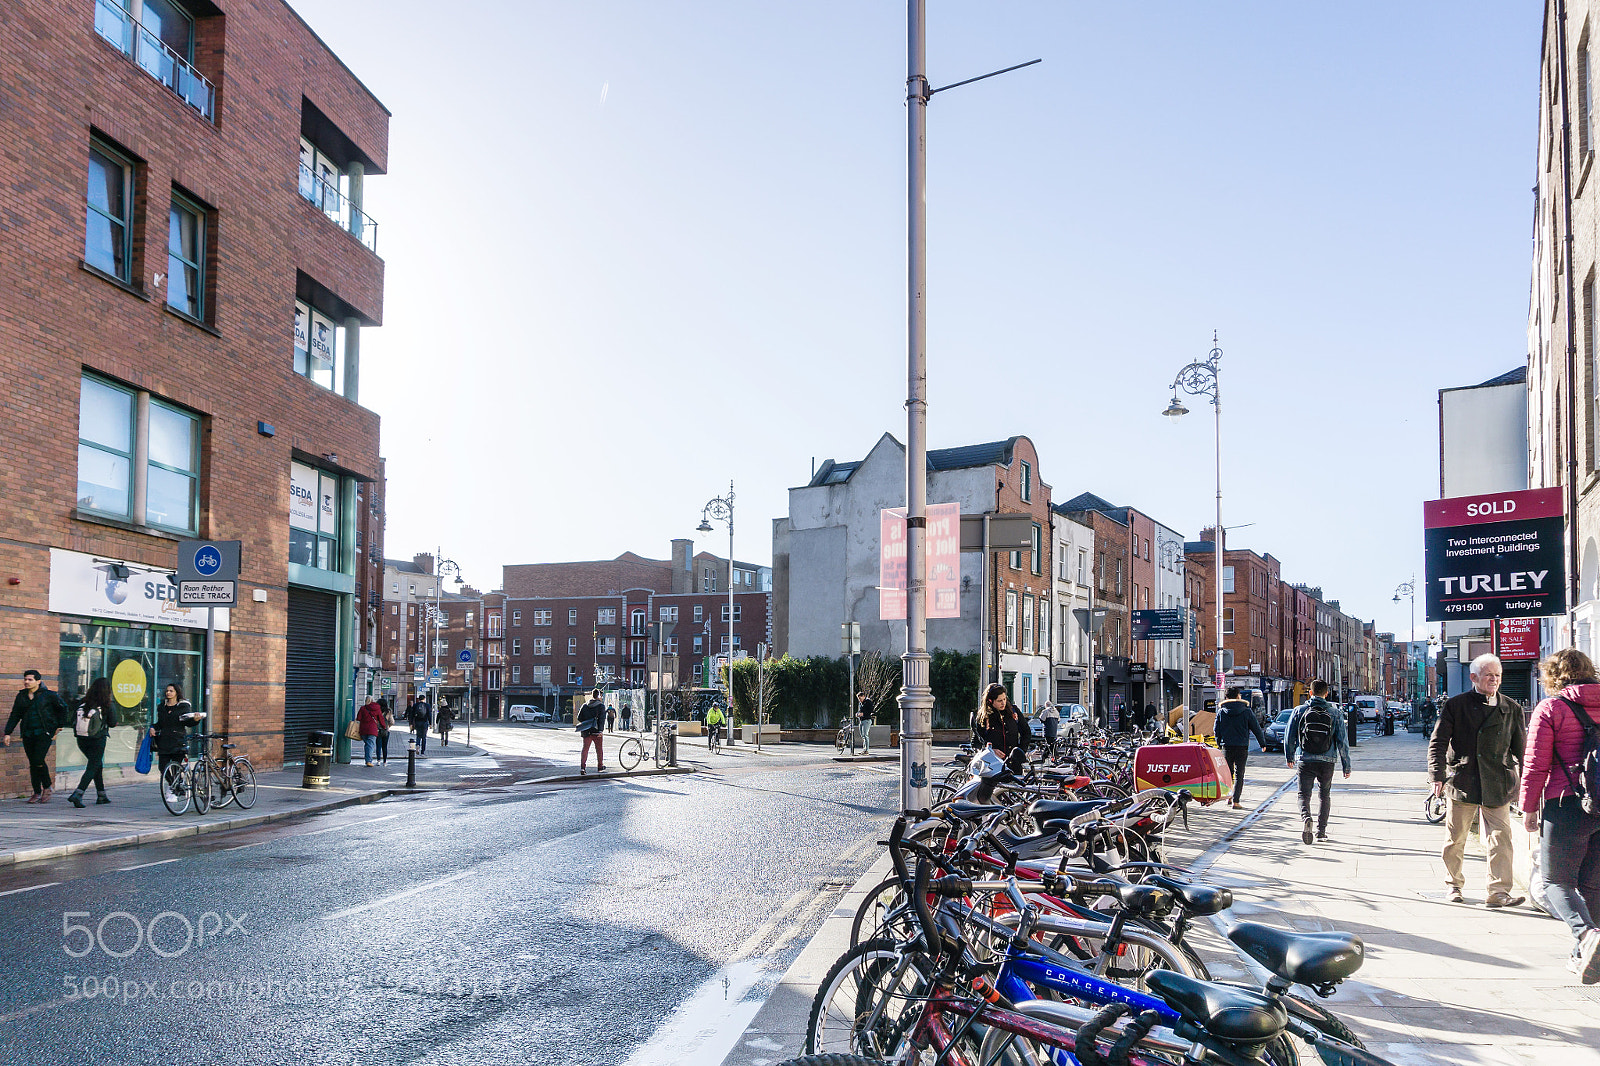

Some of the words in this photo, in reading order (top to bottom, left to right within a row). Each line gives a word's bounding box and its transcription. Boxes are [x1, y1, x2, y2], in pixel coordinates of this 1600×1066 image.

[312, 337, 330, 356] SEDA
[290, 484, 313, 501] SEDA
[1466, 500, 1517, 517] SOLD
[1448, 537, 1467, 547] Two
[1469, 531, 1538, 545] Interconnected
[1446, 546, 1496, 557] Investment
[1497, 542, 1540, 554] Buildings
[1438, 569, 1549, 595] TURLEY
[144, 581, 178, 601] SED
[183, 592, 205, 600] CYCLE
[207, 592, 231, 600] TRACK
[1445, 603, 1484, 613] 4791500
[1505, 600, 1542, 611] turley.ie
[1510, 619, 1535, 627] Knight
[117, 683, 142, 694] SEDA
[1146, 764, 1171, 774] JUST
[1171, 764, 1191, 773] EAT
[1045, 969, 1131, 1003] CONCEPT
